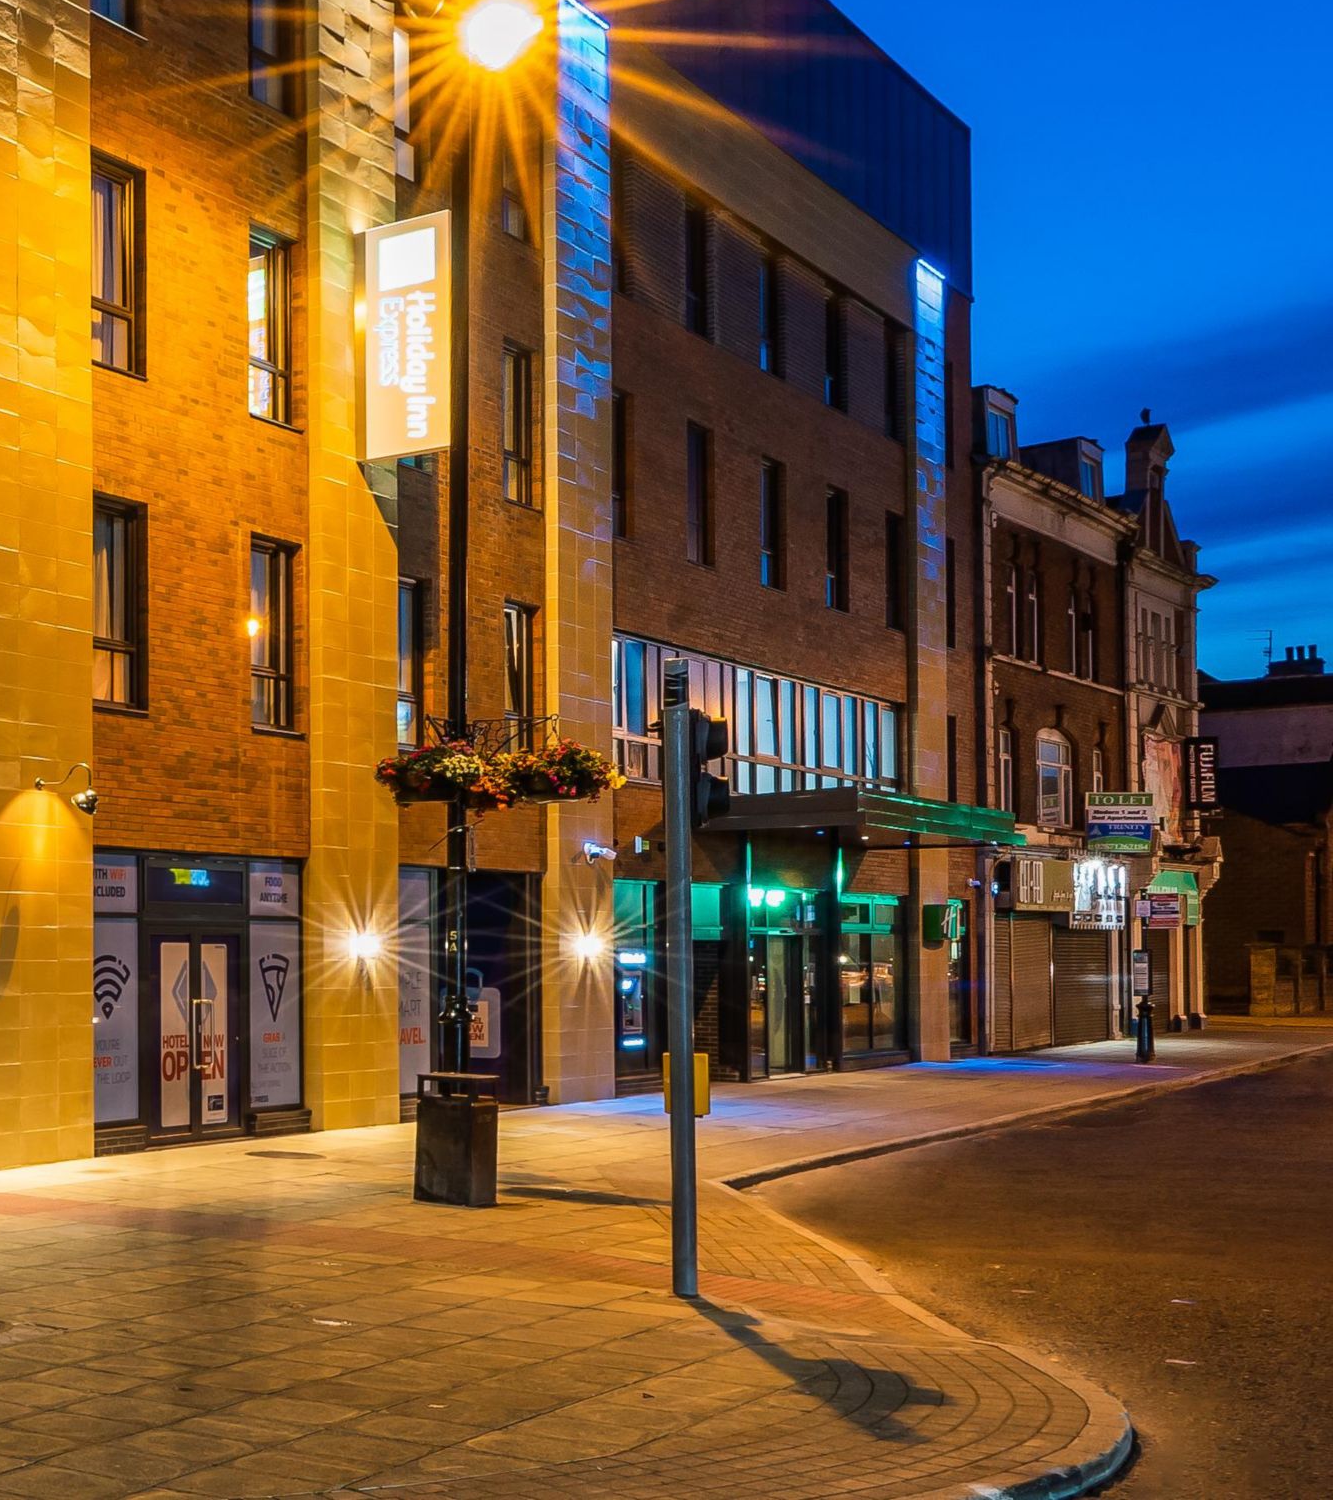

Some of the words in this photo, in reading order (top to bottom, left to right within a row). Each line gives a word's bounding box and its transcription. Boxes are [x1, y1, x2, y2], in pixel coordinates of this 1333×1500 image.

[373, 296, 405, 387] Express
[400, 291, 435, 393] Holiday
[406, 395, 436, 439] Inn
[1092, 795, 1115, 805] TO
[1119, 795, 1150, 805] LET
[94, 868, 108, 879] ITH
[162, 1035, 189, 1049] HOTEL
[203, 1034, 224, 1048] NOW
[400, 1028, 426, 1045] AVEL.
[93, 1056, 112, 1068] EVER
[162, 1050, 224, 1081] OPEN
